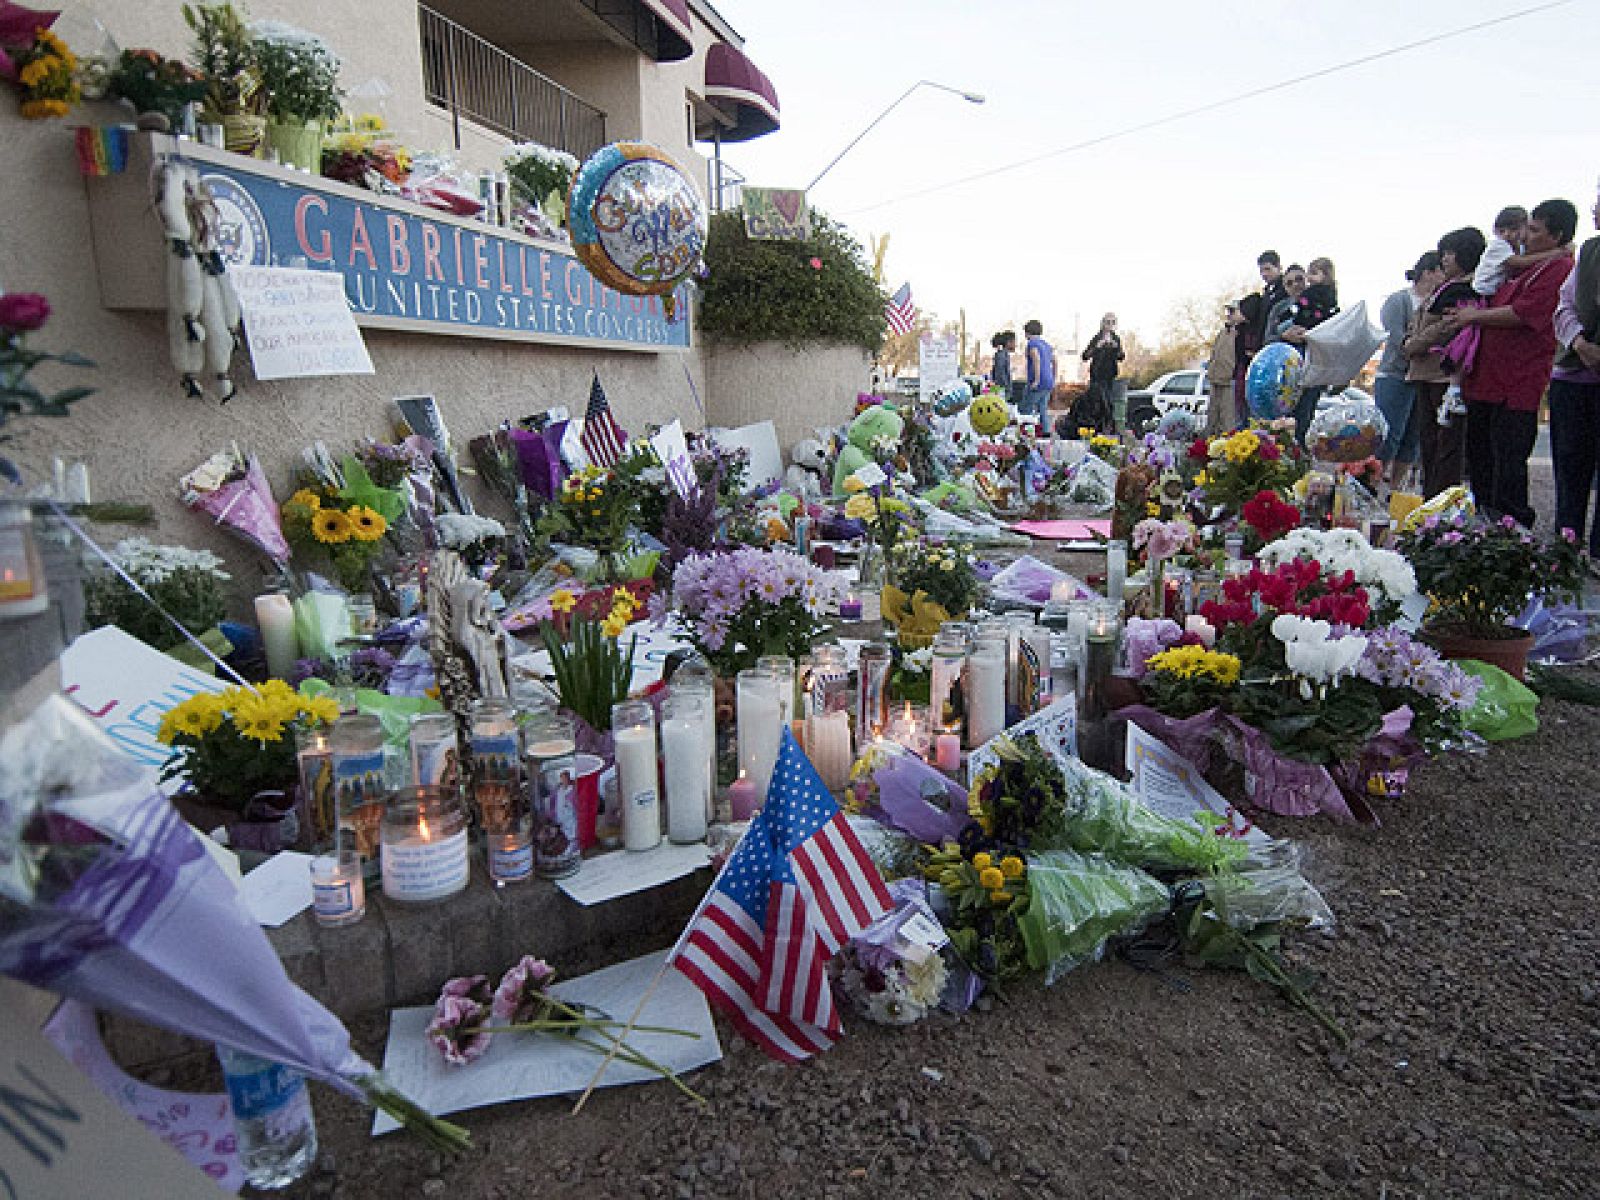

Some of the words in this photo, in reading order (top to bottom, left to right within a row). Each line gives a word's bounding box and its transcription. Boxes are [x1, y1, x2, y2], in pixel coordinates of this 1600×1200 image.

[295, 194, 552, 301] GABRIELLE
[564, 259, 685, 322] GIORS
[356, 273, 481, 324] UNITED
[495, 294, 576, 336] STATES
[584, 308, 669, 345] CONGRESS
